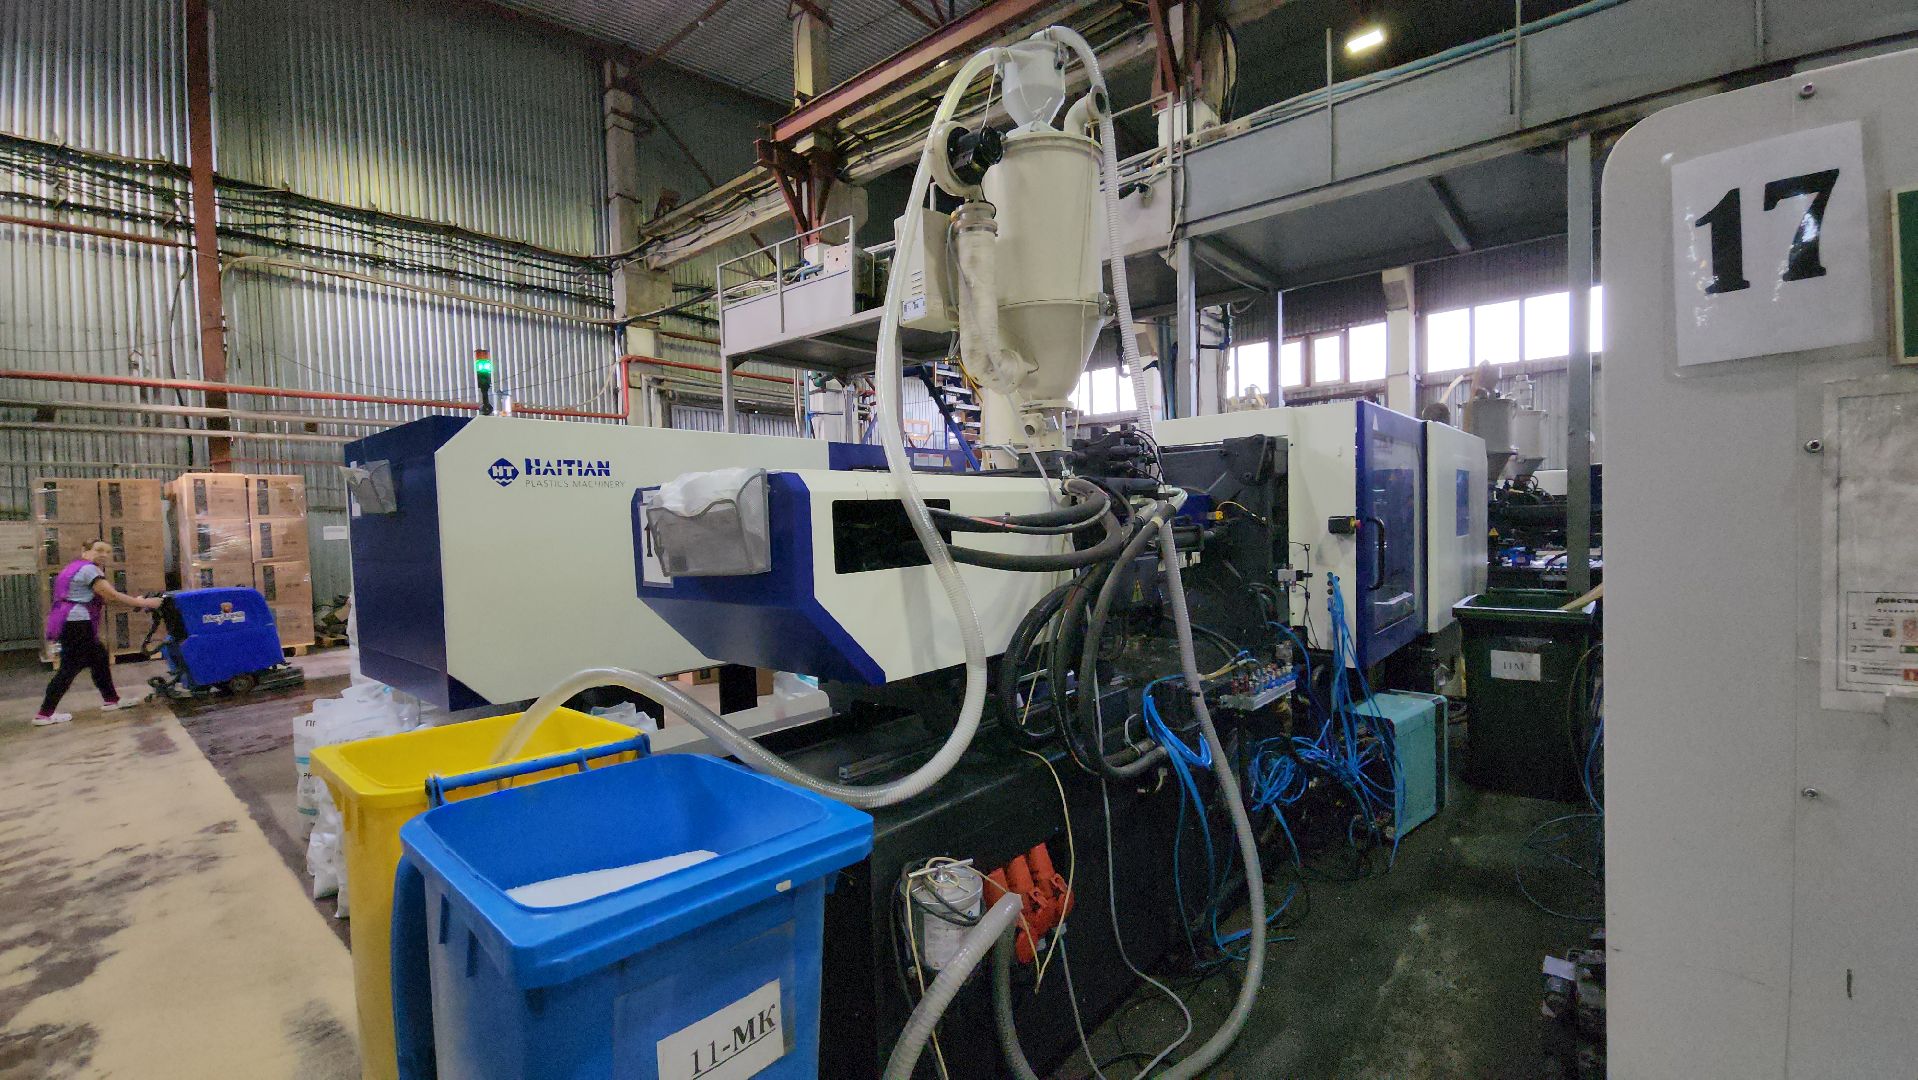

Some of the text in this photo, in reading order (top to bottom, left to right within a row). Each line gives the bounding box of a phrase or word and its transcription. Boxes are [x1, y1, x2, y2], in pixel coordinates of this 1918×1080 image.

[1695, 168, 1840, 294] 17
[524, 458, 611, 476] HAITIAN
[525, 479, 625, 489] PLASTICS MACHINERY
[1850, 664, 1857, 673] 3
